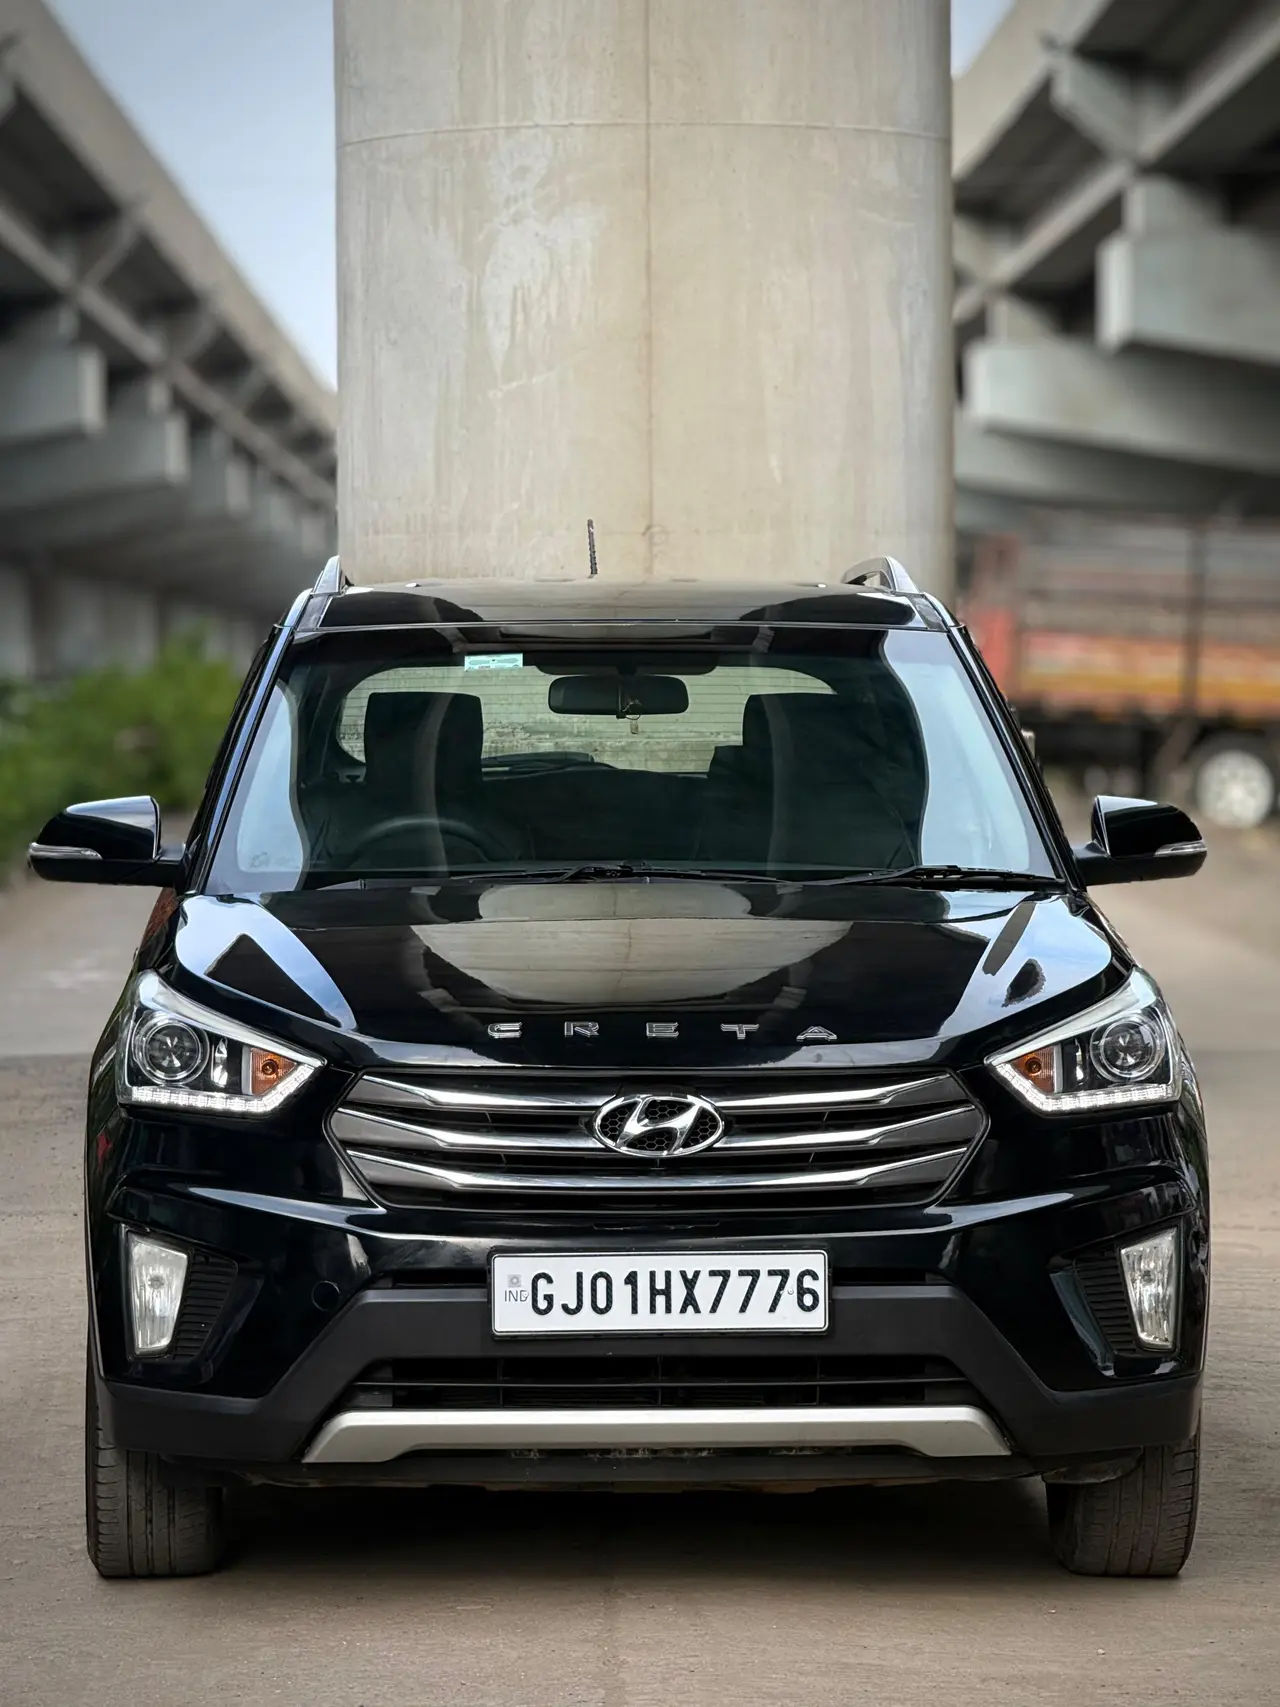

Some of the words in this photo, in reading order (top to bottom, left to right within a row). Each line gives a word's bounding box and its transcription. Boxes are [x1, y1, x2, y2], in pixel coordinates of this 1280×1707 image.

[487, 1021, 837, 1041] CRETA
[504, 1289, 529, 1302] IND
[531, 1269, 819, 1315] GJ01HX7776
